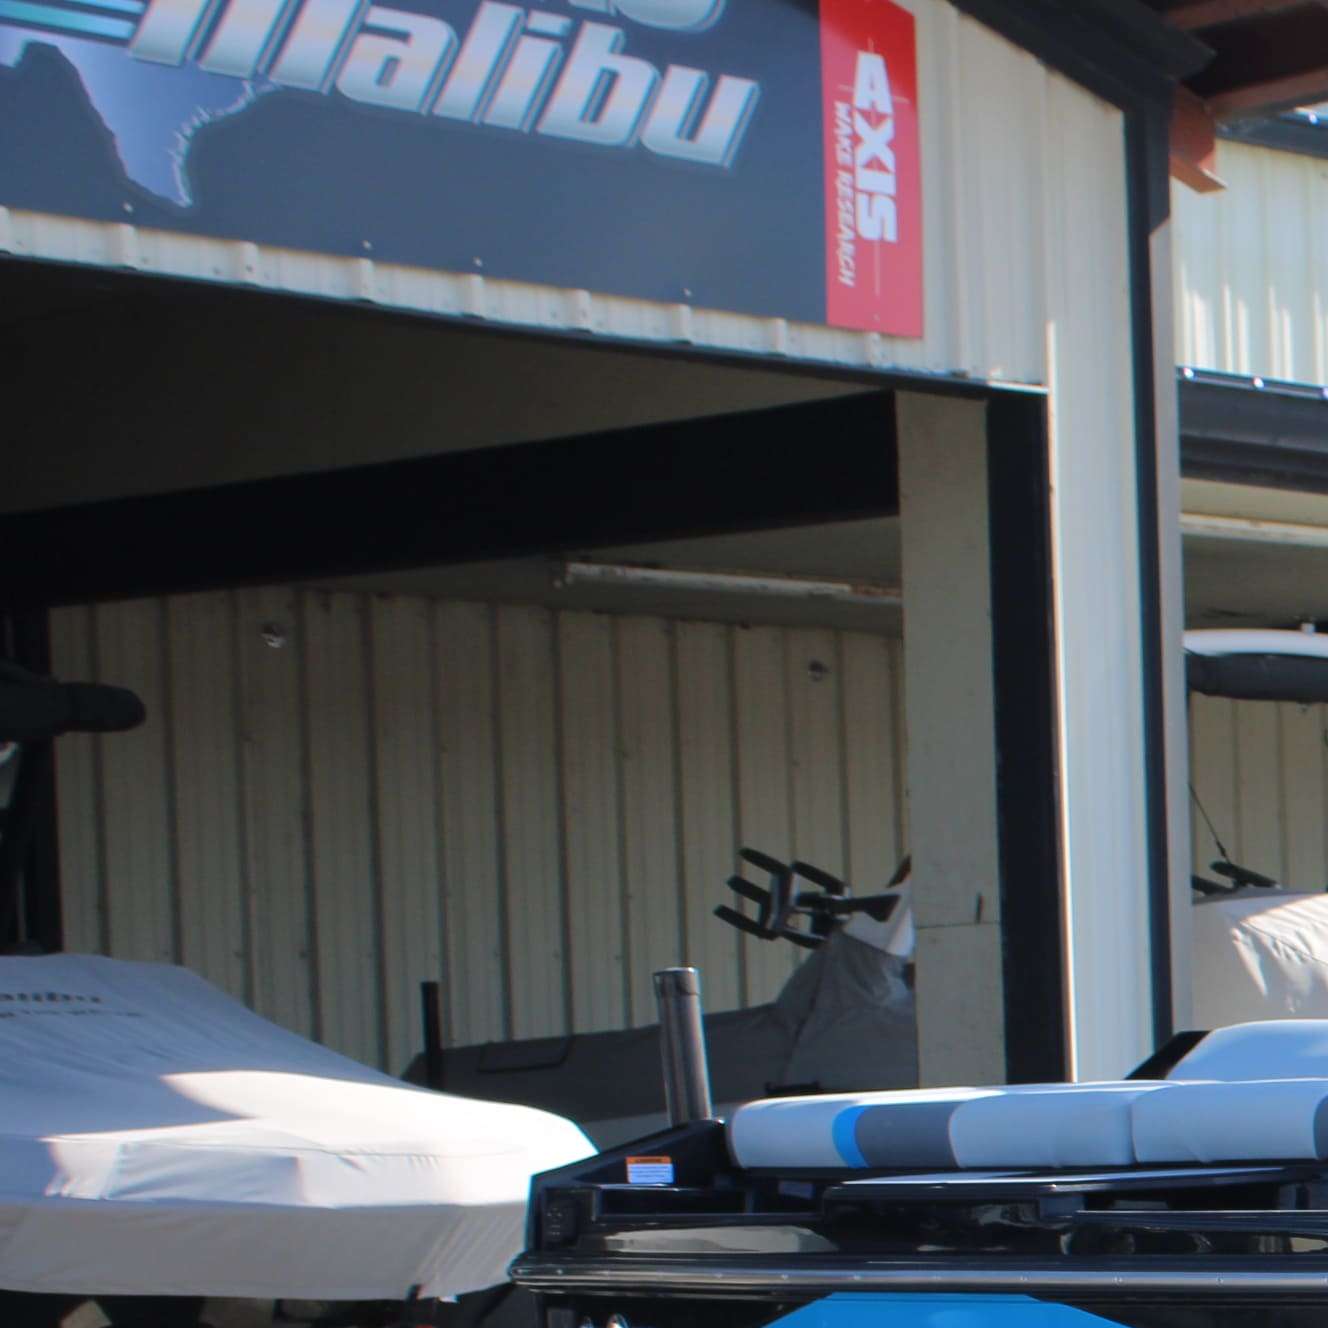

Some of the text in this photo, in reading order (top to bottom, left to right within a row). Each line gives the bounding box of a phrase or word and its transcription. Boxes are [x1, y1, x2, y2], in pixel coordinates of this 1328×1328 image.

[834, 101, 857, 287] WAKE RESEARCH
[853, 50, 898, 243] AXIS
